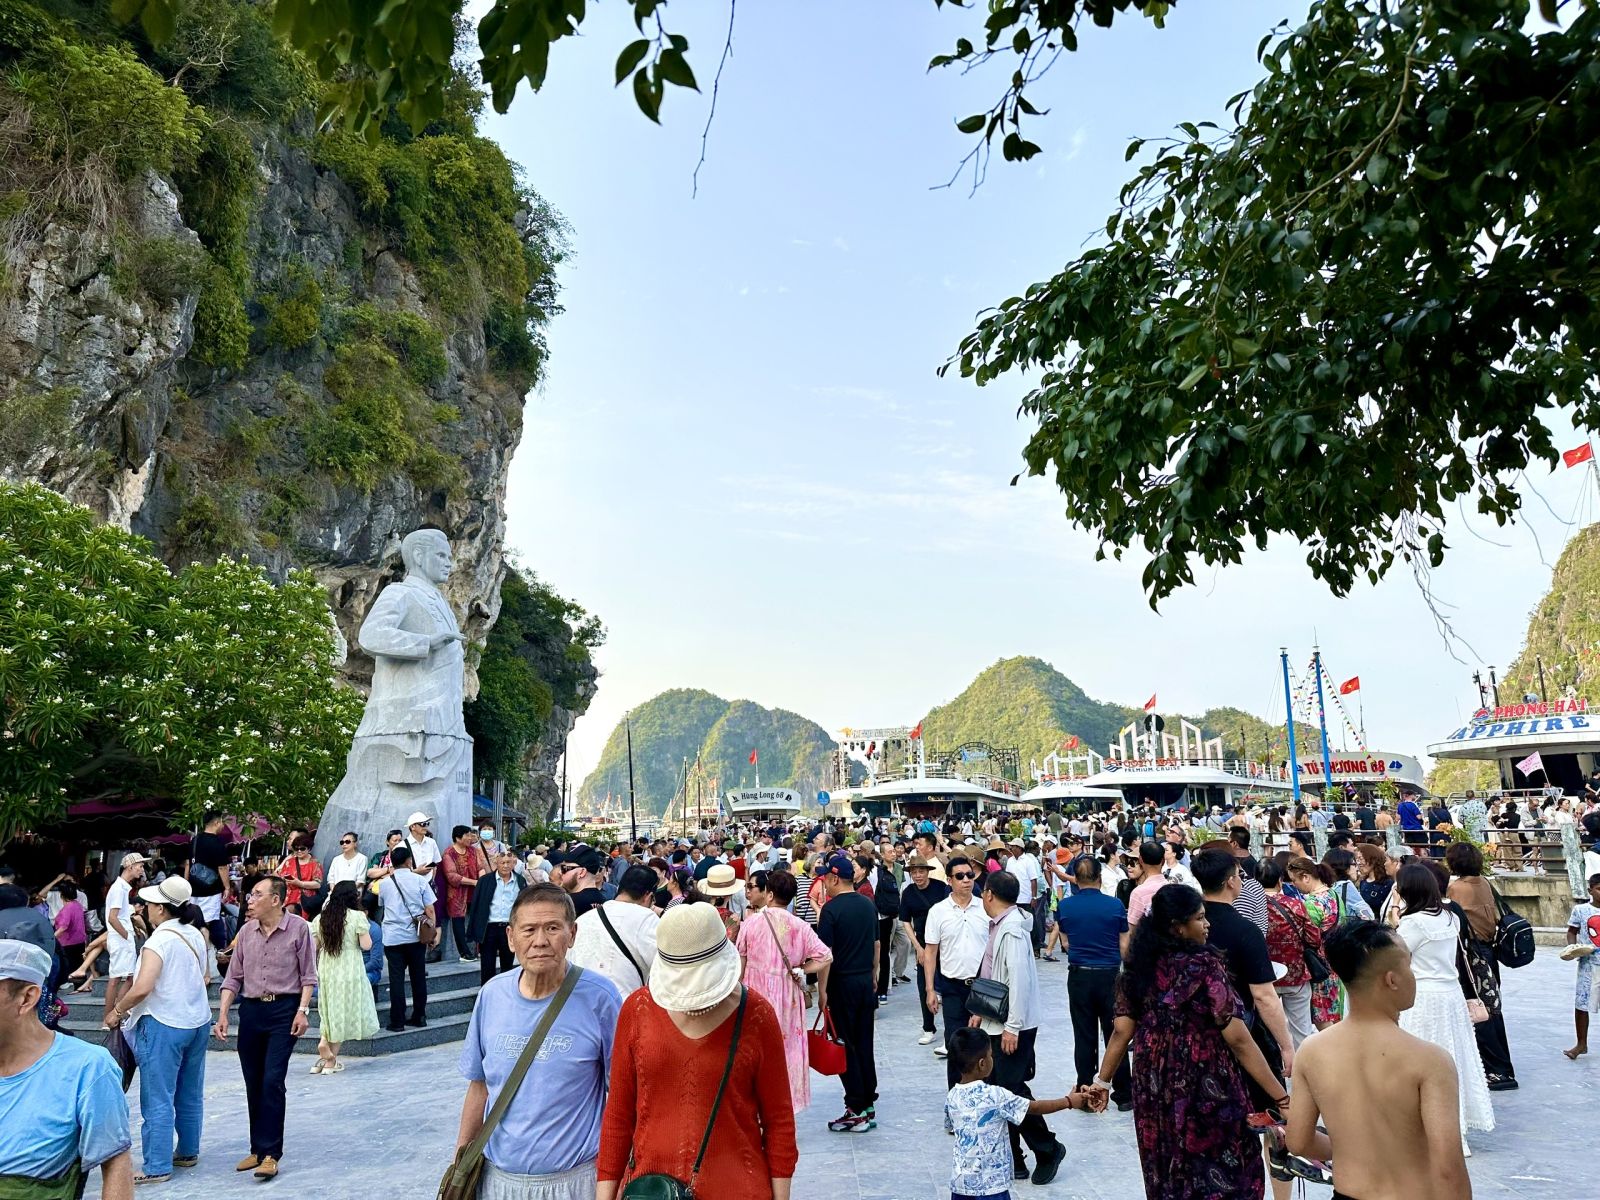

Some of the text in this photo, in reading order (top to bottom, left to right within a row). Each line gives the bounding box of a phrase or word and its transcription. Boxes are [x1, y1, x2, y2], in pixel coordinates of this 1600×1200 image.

[1494, 702, 1549, 718] PHONG
[1370, 760, 1386, 773] 68
[760, 791, 775, 800] Long
[775, 791, 784, 799] 68
